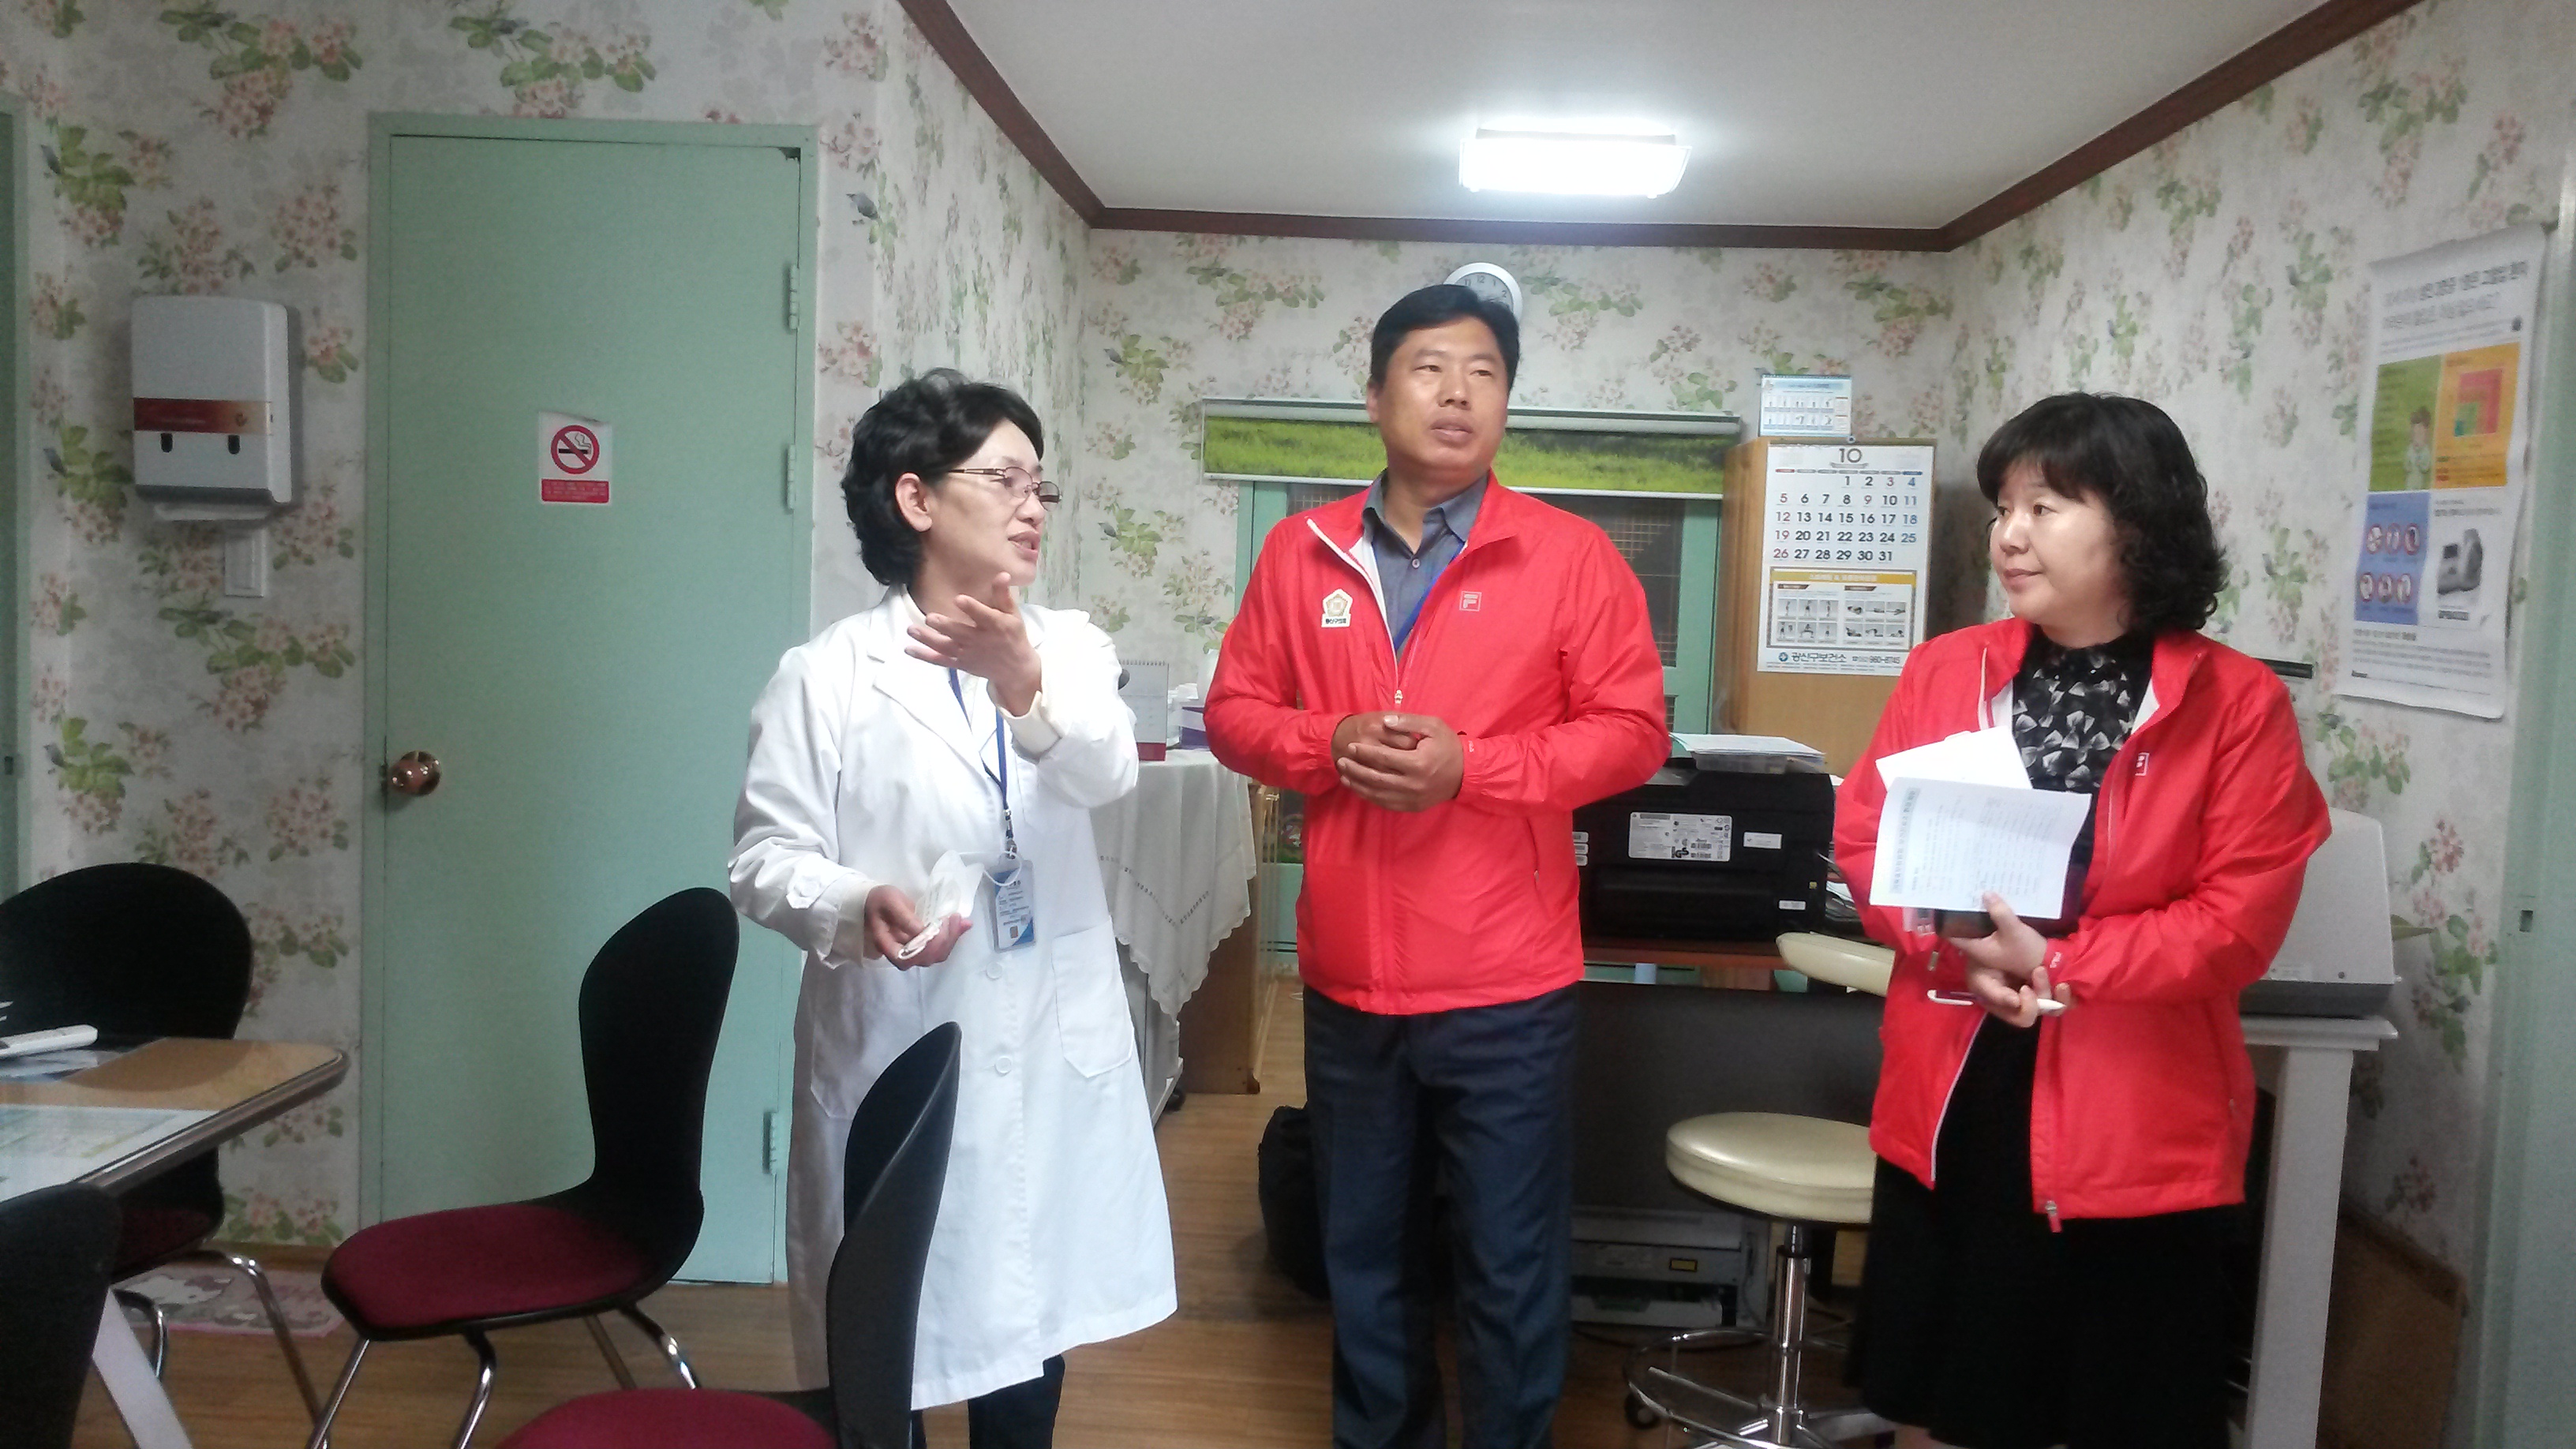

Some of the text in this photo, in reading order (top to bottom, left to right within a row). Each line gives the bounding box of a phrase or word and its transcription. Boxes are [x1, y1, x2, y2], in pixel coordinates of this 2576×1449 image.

[1501, 290, 1507, 298] 2
[1839, 448, 1862, 462] 10
[1845, 476, 1915, 487] 1 2 3 4
[1780, 493, 1917, 506] 5 6 7 8 9 10 11
[1776, 511, 1918, 525] 12 13 14 15 16 17 18
[1776, 530, 1917, 543] 19 20 21 22 23 24 25
[1773, 549, 1893, 561] 26 27 28 29 30 31
[1791, 652, 1847, 663] 광산구보건소
